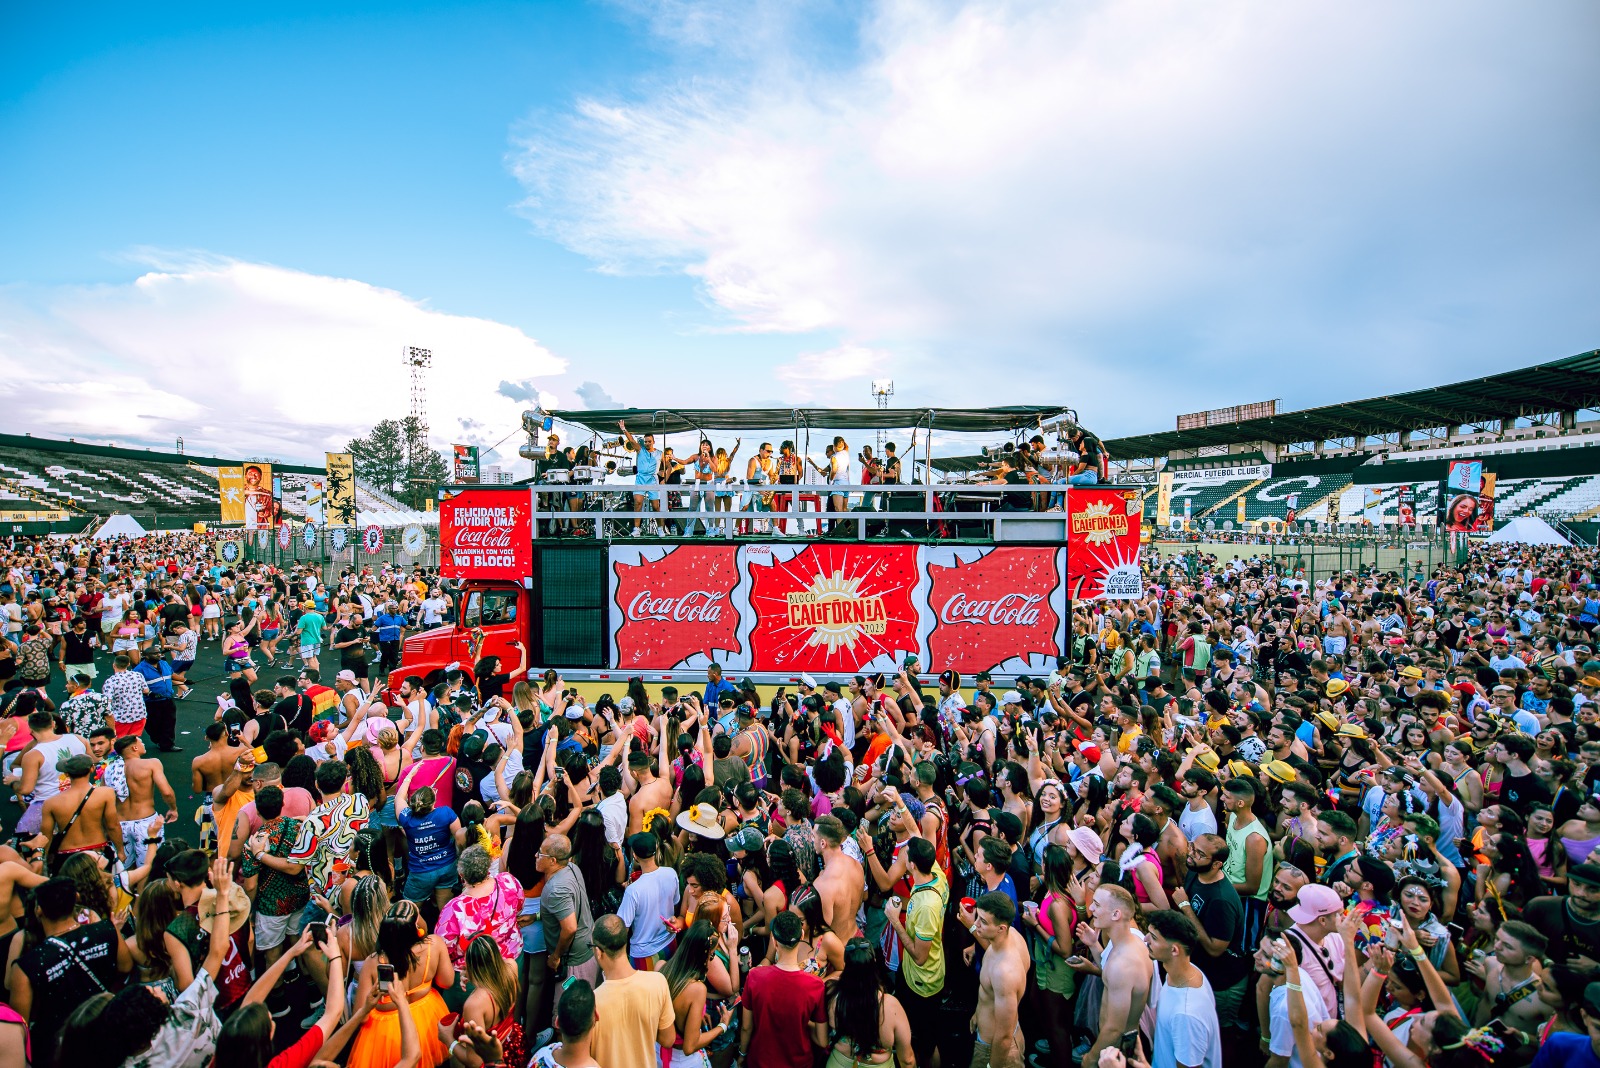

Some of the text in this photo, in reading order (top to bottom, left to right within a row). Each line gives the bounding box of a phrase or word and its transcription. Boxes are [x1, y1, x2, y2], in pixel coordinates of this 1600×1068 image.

[1173, 466, 1260, 480] MERCIAL FUTEBOL CLUBE
[454, 507, 506, 518] FELICIDADE
[454, 517, 515, 527] DIVIDIR UMA
[455, 527, 514, 547] Coca-Cola
[746, 546, 770, 554] Coca-Cola
[455, 554, 516, 567] NO BLOCO!
[1109, 574, 1140, 584] Coca-Cola
[789, 593, 816, 604] BLOCO
[628, 590, 728, 622] Coca-Cola
[941, 592, 1046, 626] Coca-Cola
[865, 624, 885, 634] 2023
[79, 943, 108, 956] NOITES
[46, 959, 68, 975] ONDE
